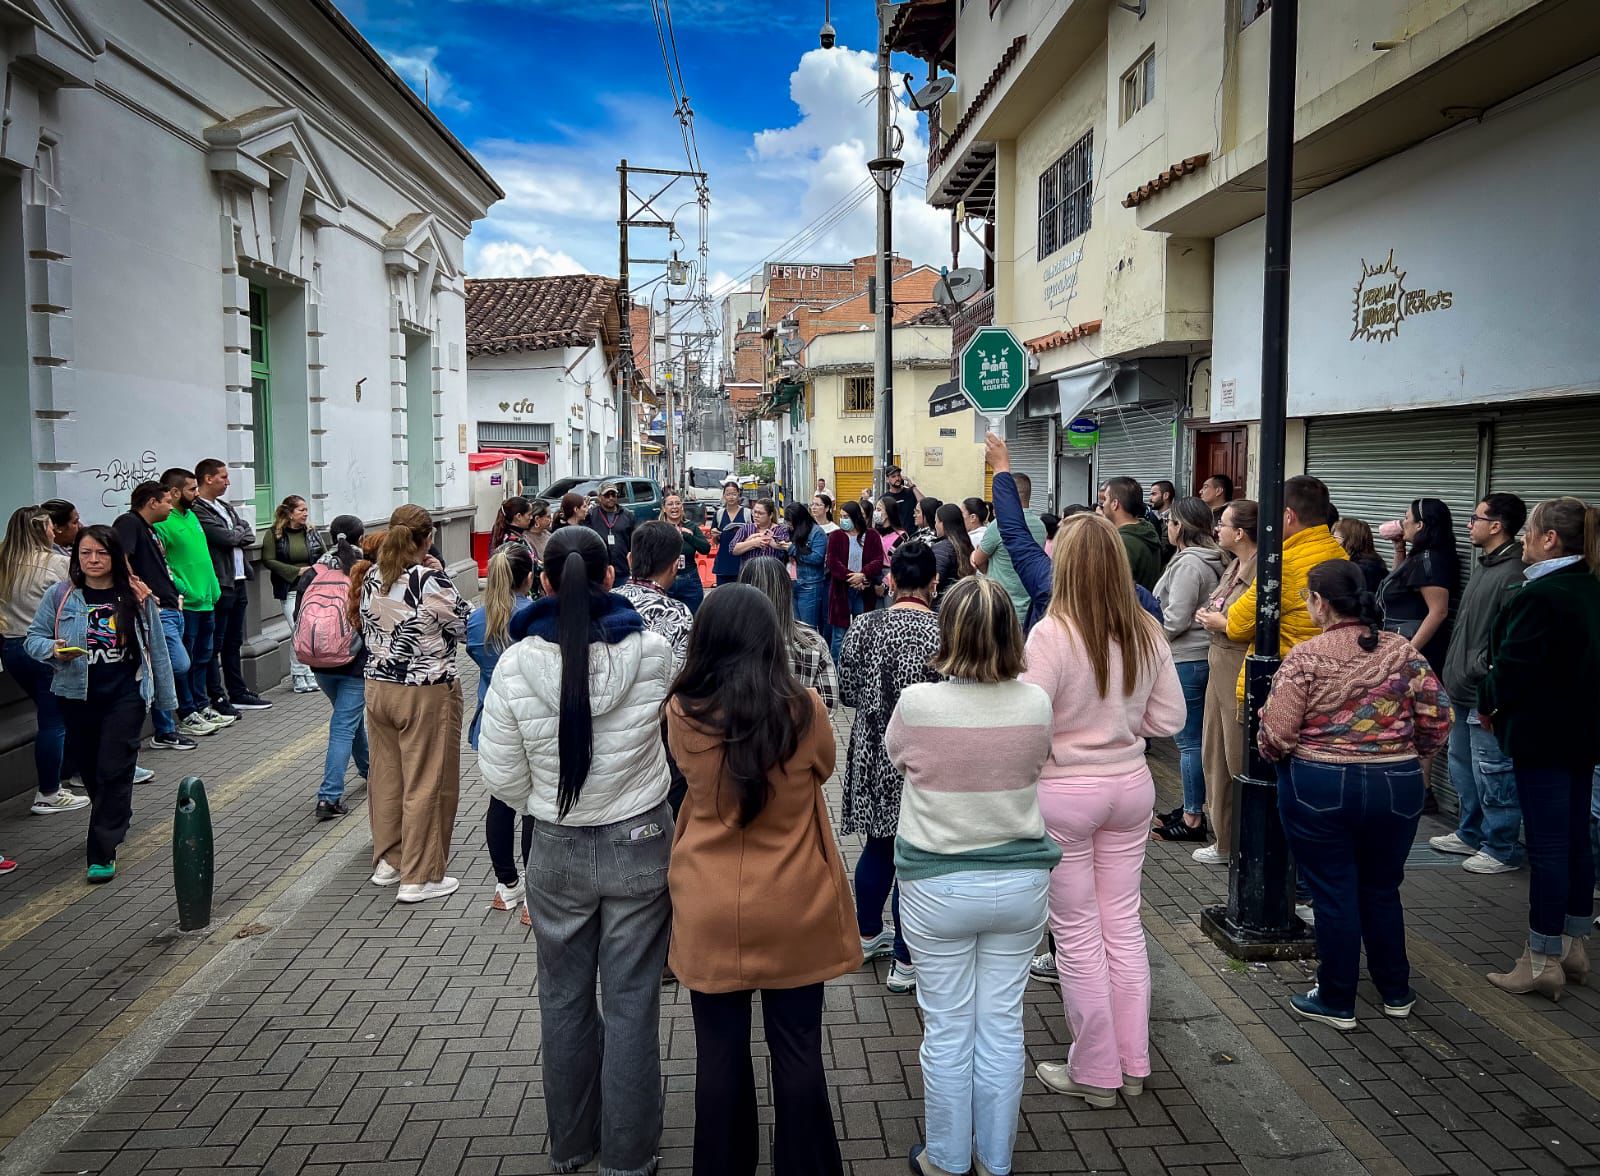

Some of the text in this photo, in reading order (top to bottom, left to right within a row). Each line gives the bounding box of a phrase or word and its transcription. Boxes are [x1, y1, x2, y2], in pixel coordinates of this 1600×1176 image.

[771, 265, 820, 279] ASYS
[982, 378, 1000, 386] PUNTO
[513, 398, 534, 414] cfa
[843, 435, 854, 444] LA
